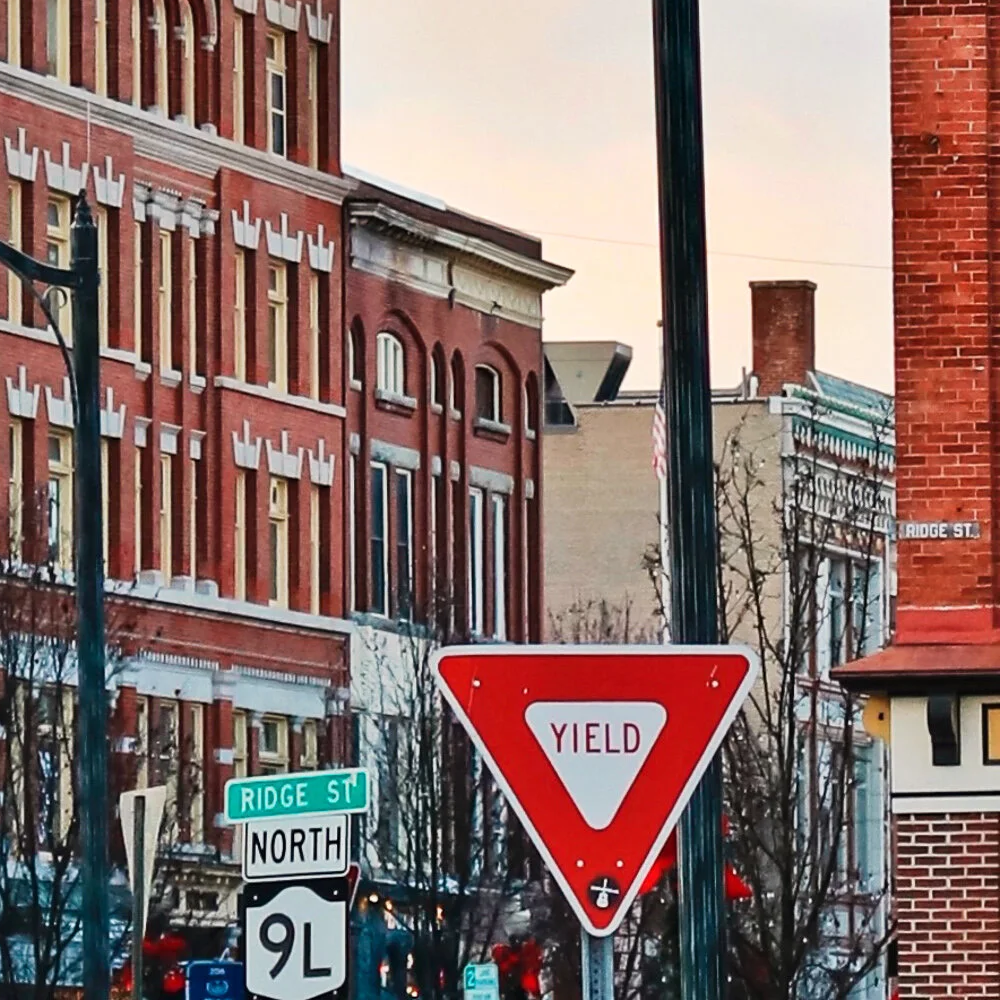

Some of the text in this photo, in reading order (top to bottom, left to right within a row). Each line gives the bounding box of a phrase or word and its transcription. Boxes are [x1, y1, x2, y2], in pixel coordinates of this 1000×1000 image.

[905, 523, 948, 538] RIDGE
[550, 722, 641, 754] YIELD
[241, 775, 357, 813] RIDGE ST
[251, 826, 342, 865] NORTH
[259, 912, 332, 980] 9L
[467, 969, 475, 987] 2
